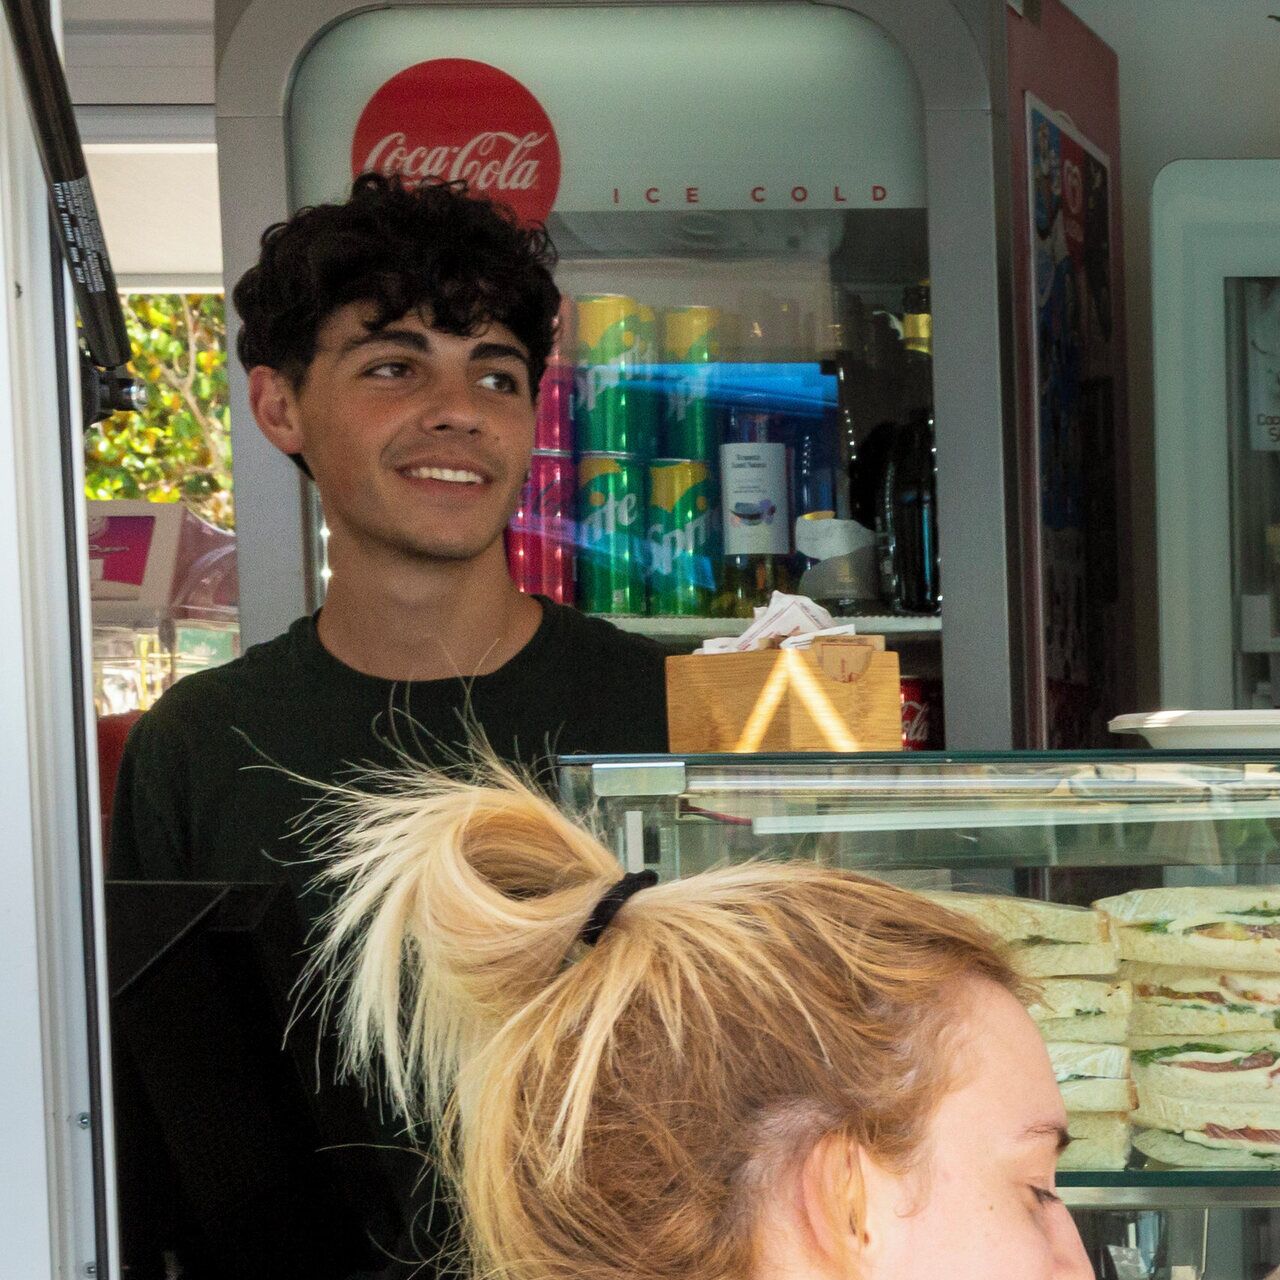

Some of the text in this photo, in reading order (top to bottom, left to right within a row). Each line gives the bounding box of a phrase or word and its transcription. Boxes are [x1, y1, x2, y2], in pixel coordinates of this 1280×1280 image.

[361, 131, 553, 190] Coca-Cola
[613, 185, 888, 203] ICE COLD
